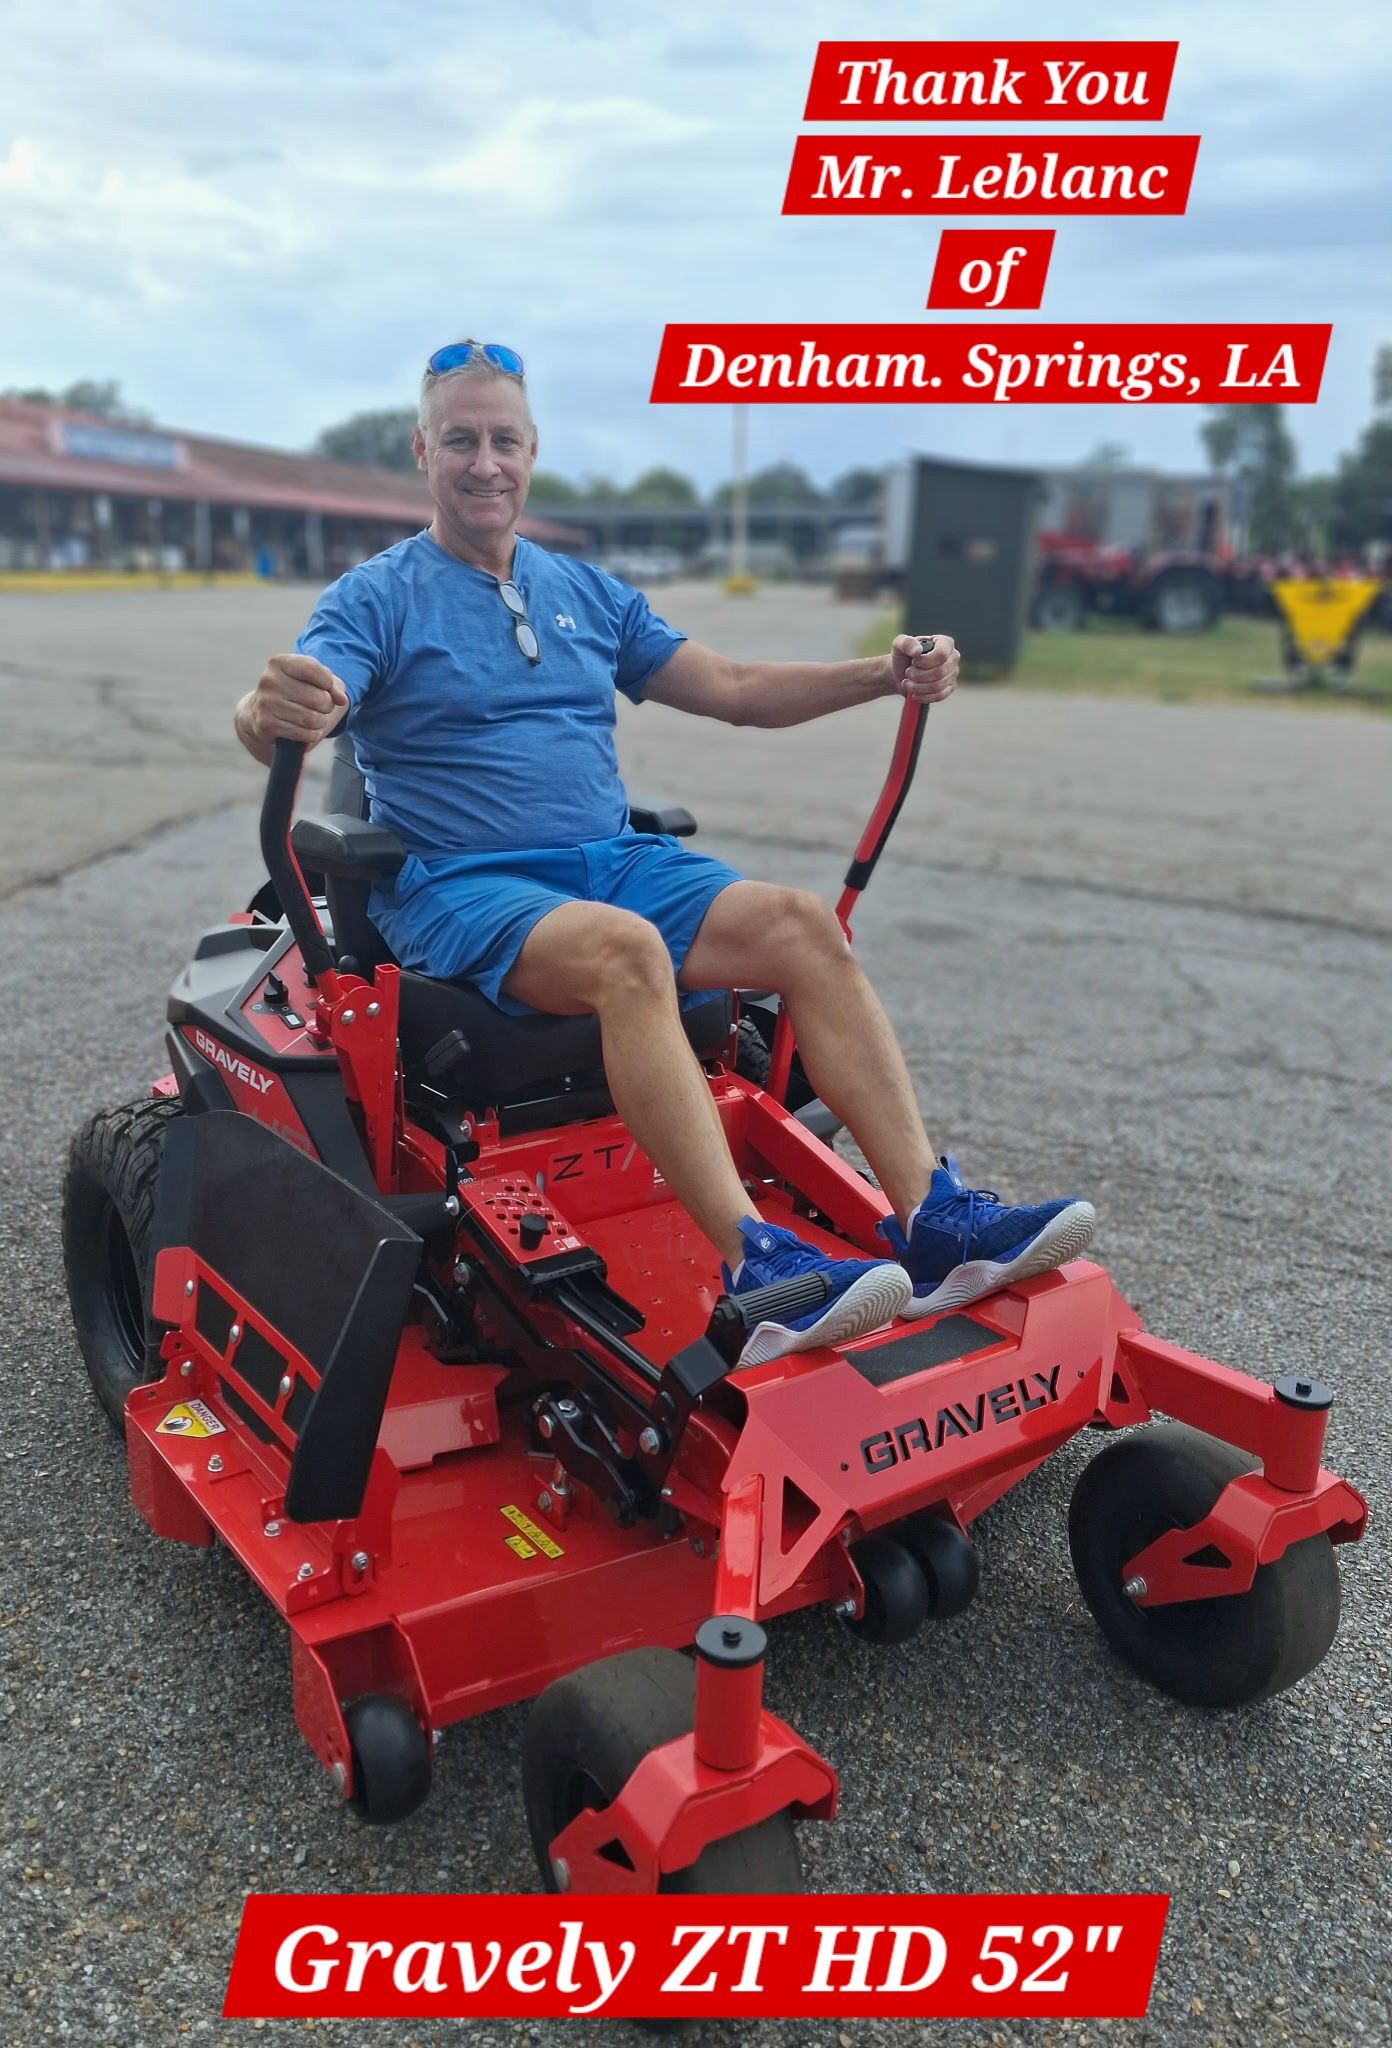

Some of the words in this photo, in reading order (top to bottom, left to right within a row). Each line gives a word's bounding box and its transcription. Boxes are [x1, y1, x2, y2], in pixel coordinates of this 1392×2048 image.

[195, 1029, 274, 1093] GRAVELY
[190, 1402, 220, 1431] DANGER
[860, 1364, 1061, 1475] GRAVELY
